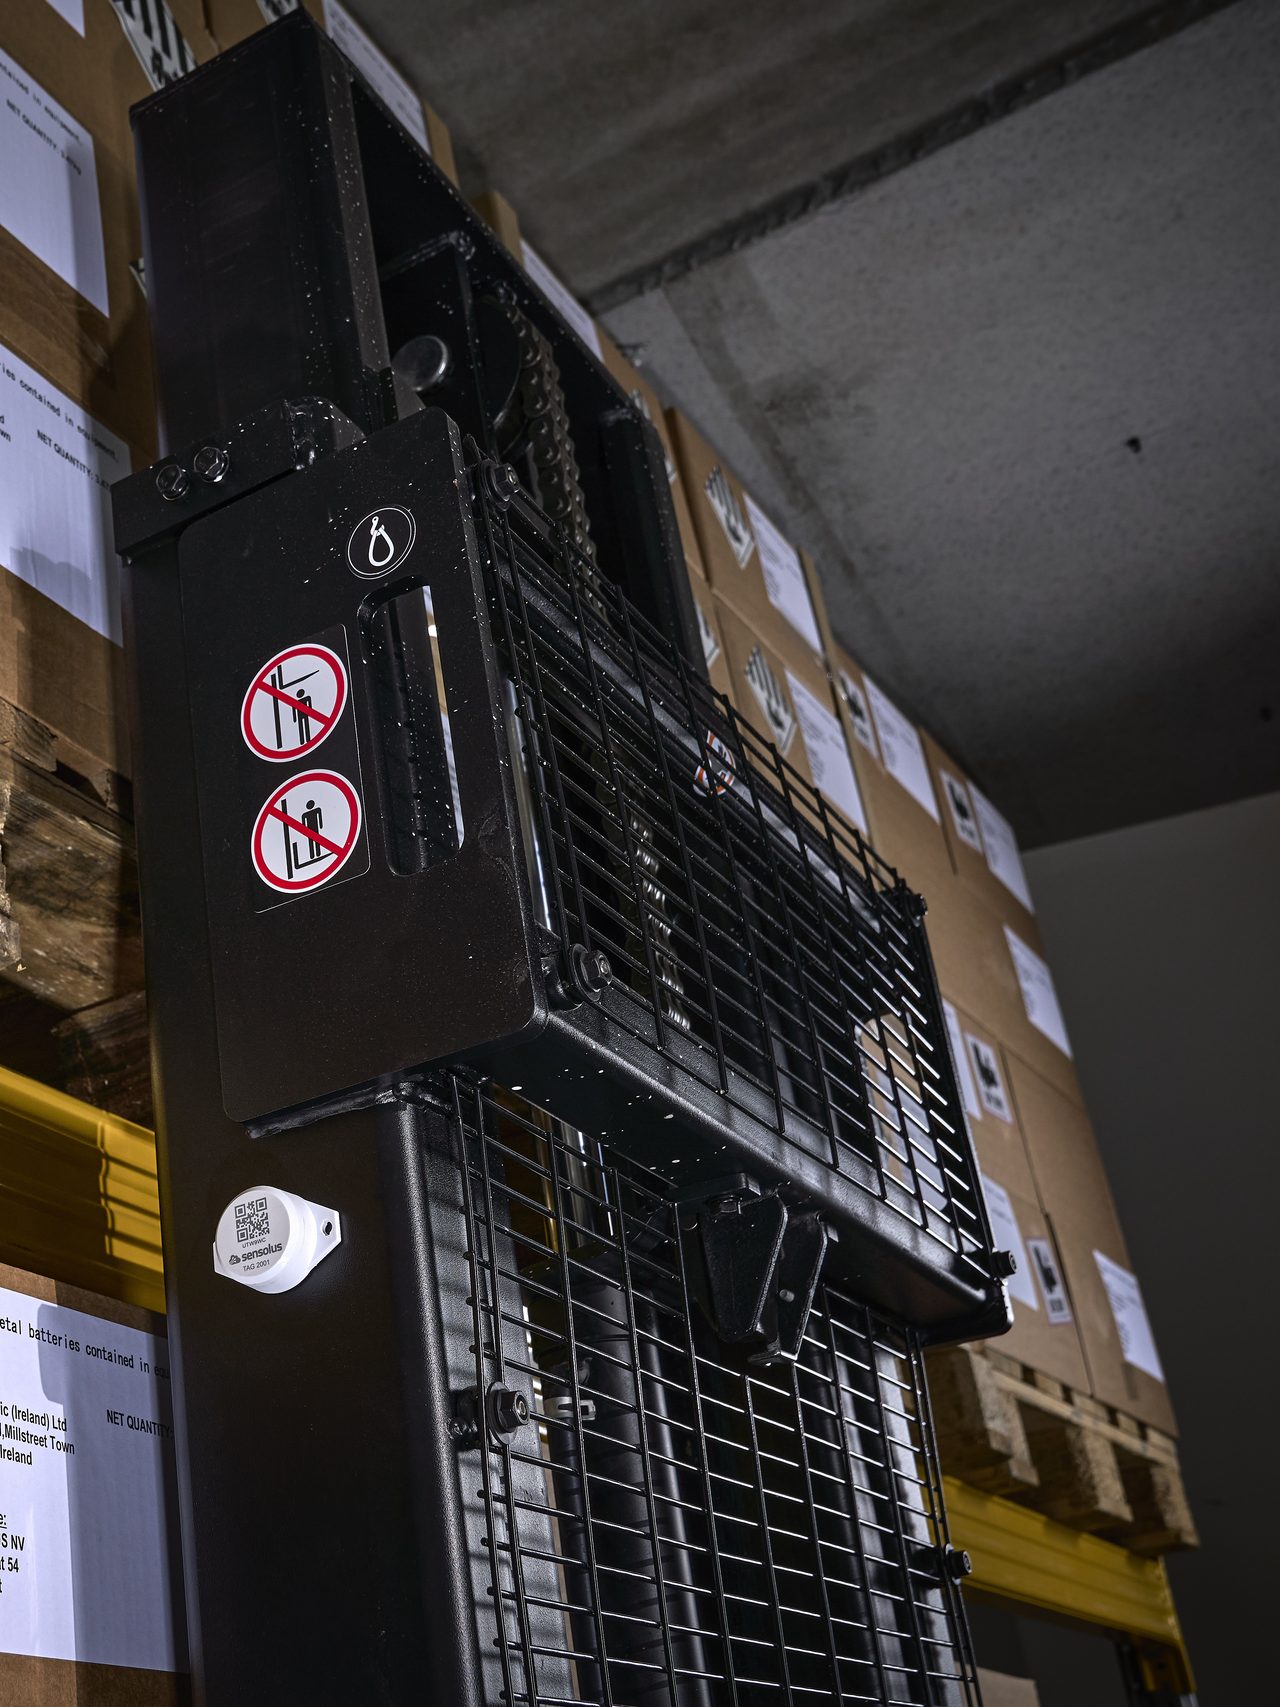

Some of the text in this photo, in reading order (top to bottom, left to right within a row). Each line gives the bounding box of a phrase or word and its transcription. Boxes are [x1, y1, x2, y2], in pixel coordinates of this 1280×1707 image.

[20, 380, 61, 417] contained
[65, 412, 75, 427] in
[37, 429, 53, 448] NET
[241, 1243, 283, 1262] sensolus
[243, 1260, 270, 1271] TAG 2001
[28, 1323, 80, 1353] batteries
[86, 1344, 134, 1369] contained
[140, 1357, 150, 1374] in
[11, 1404, 50, 1432] (Ireland)
[52, 1415, 68, 1432] Ltd
[106, 1409, 125, 1427] NET
[0, 1444, 33, 1465] Ireland
[49, 1436, 75, 1455] Town
[10, 1534, 25, 1551] NV
[7, 1556, 20, 1573] 54
